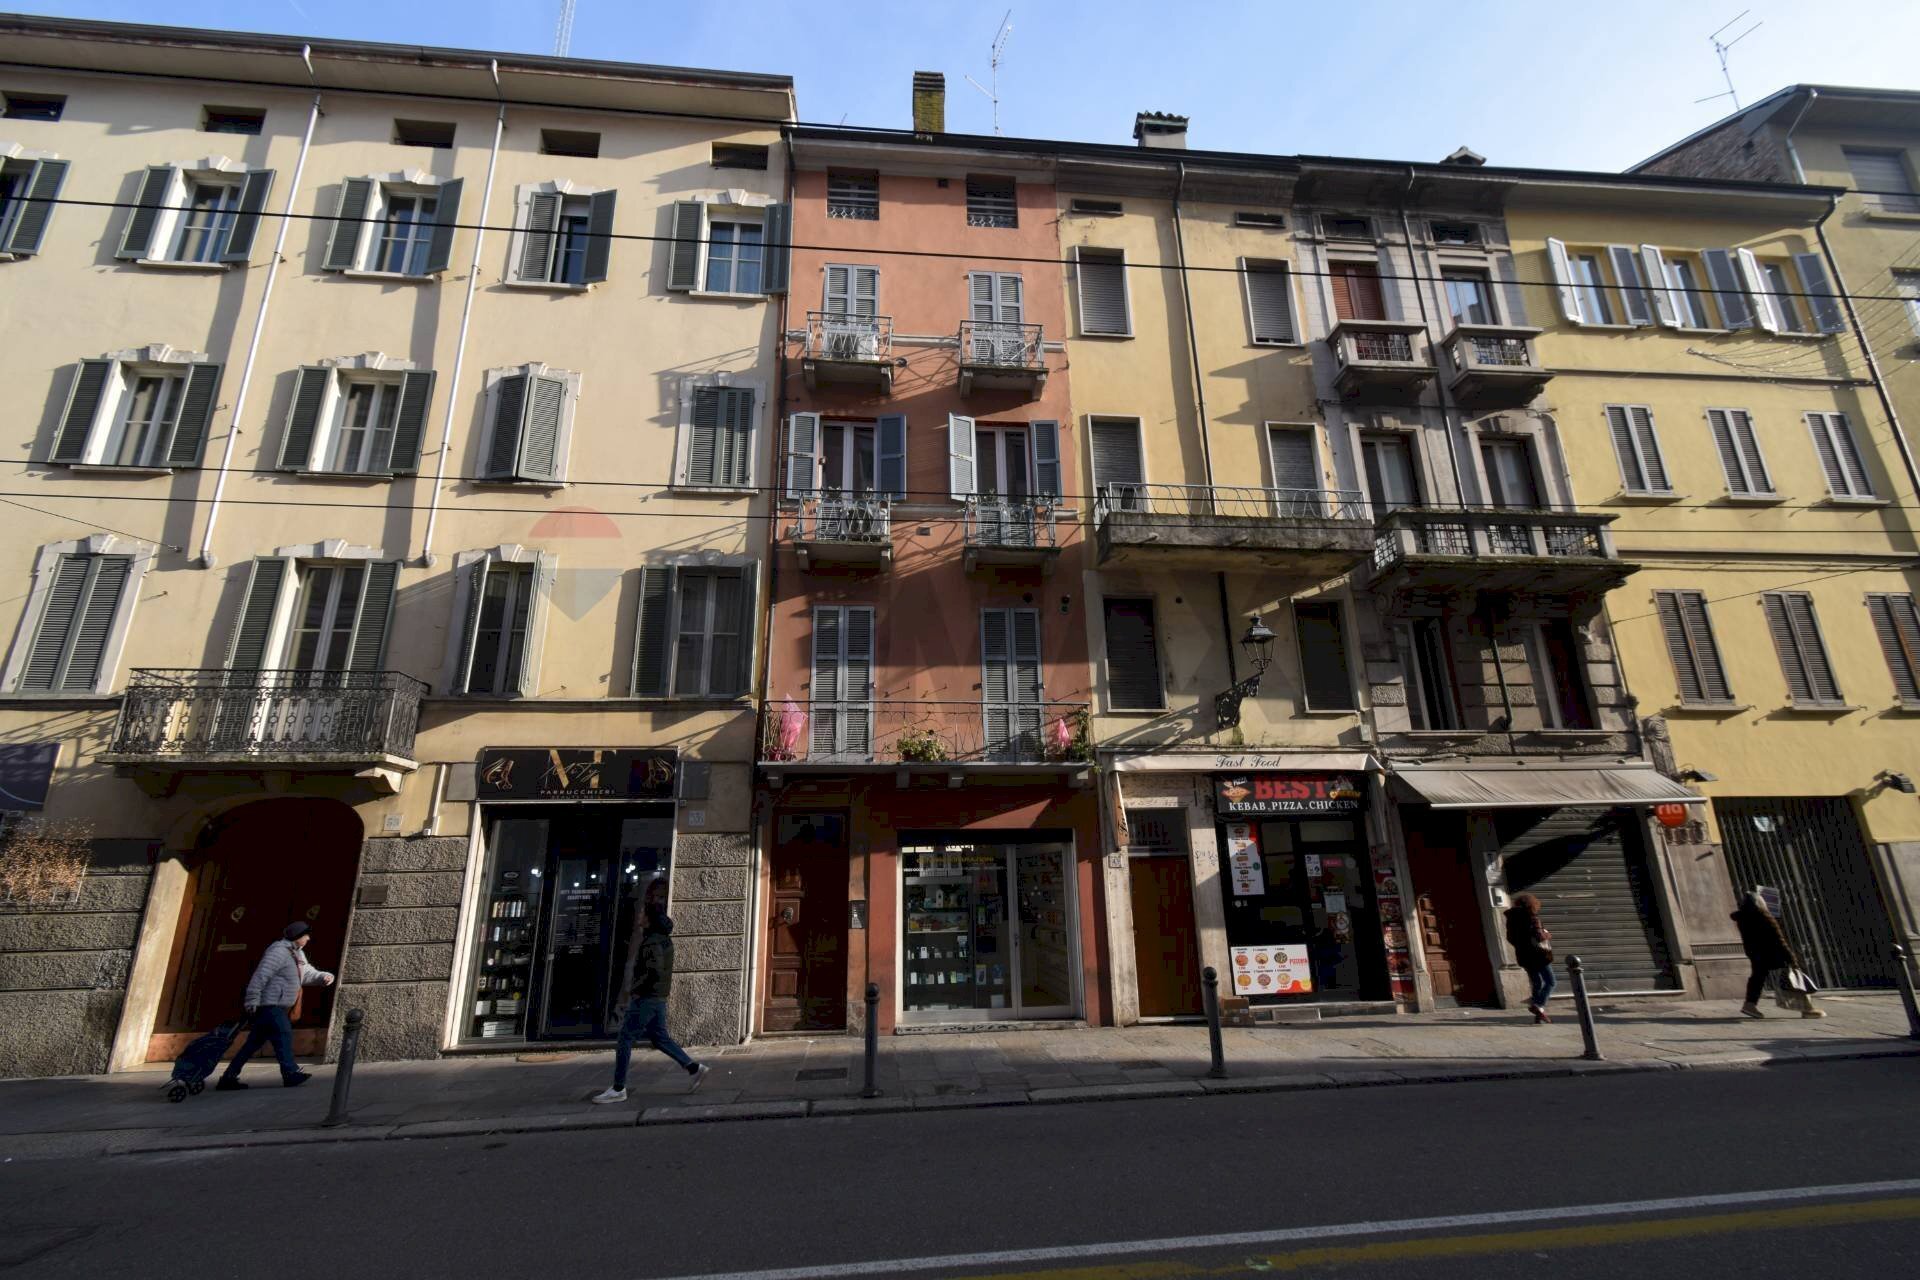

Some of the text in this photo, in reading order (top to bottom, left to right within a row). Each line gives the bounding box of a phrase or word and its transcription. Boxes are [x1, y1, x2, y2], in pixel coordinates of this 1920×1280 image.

[1215, 755, 1281, 768] Fast Food
[1254, 775, 1328, 800] BEST
